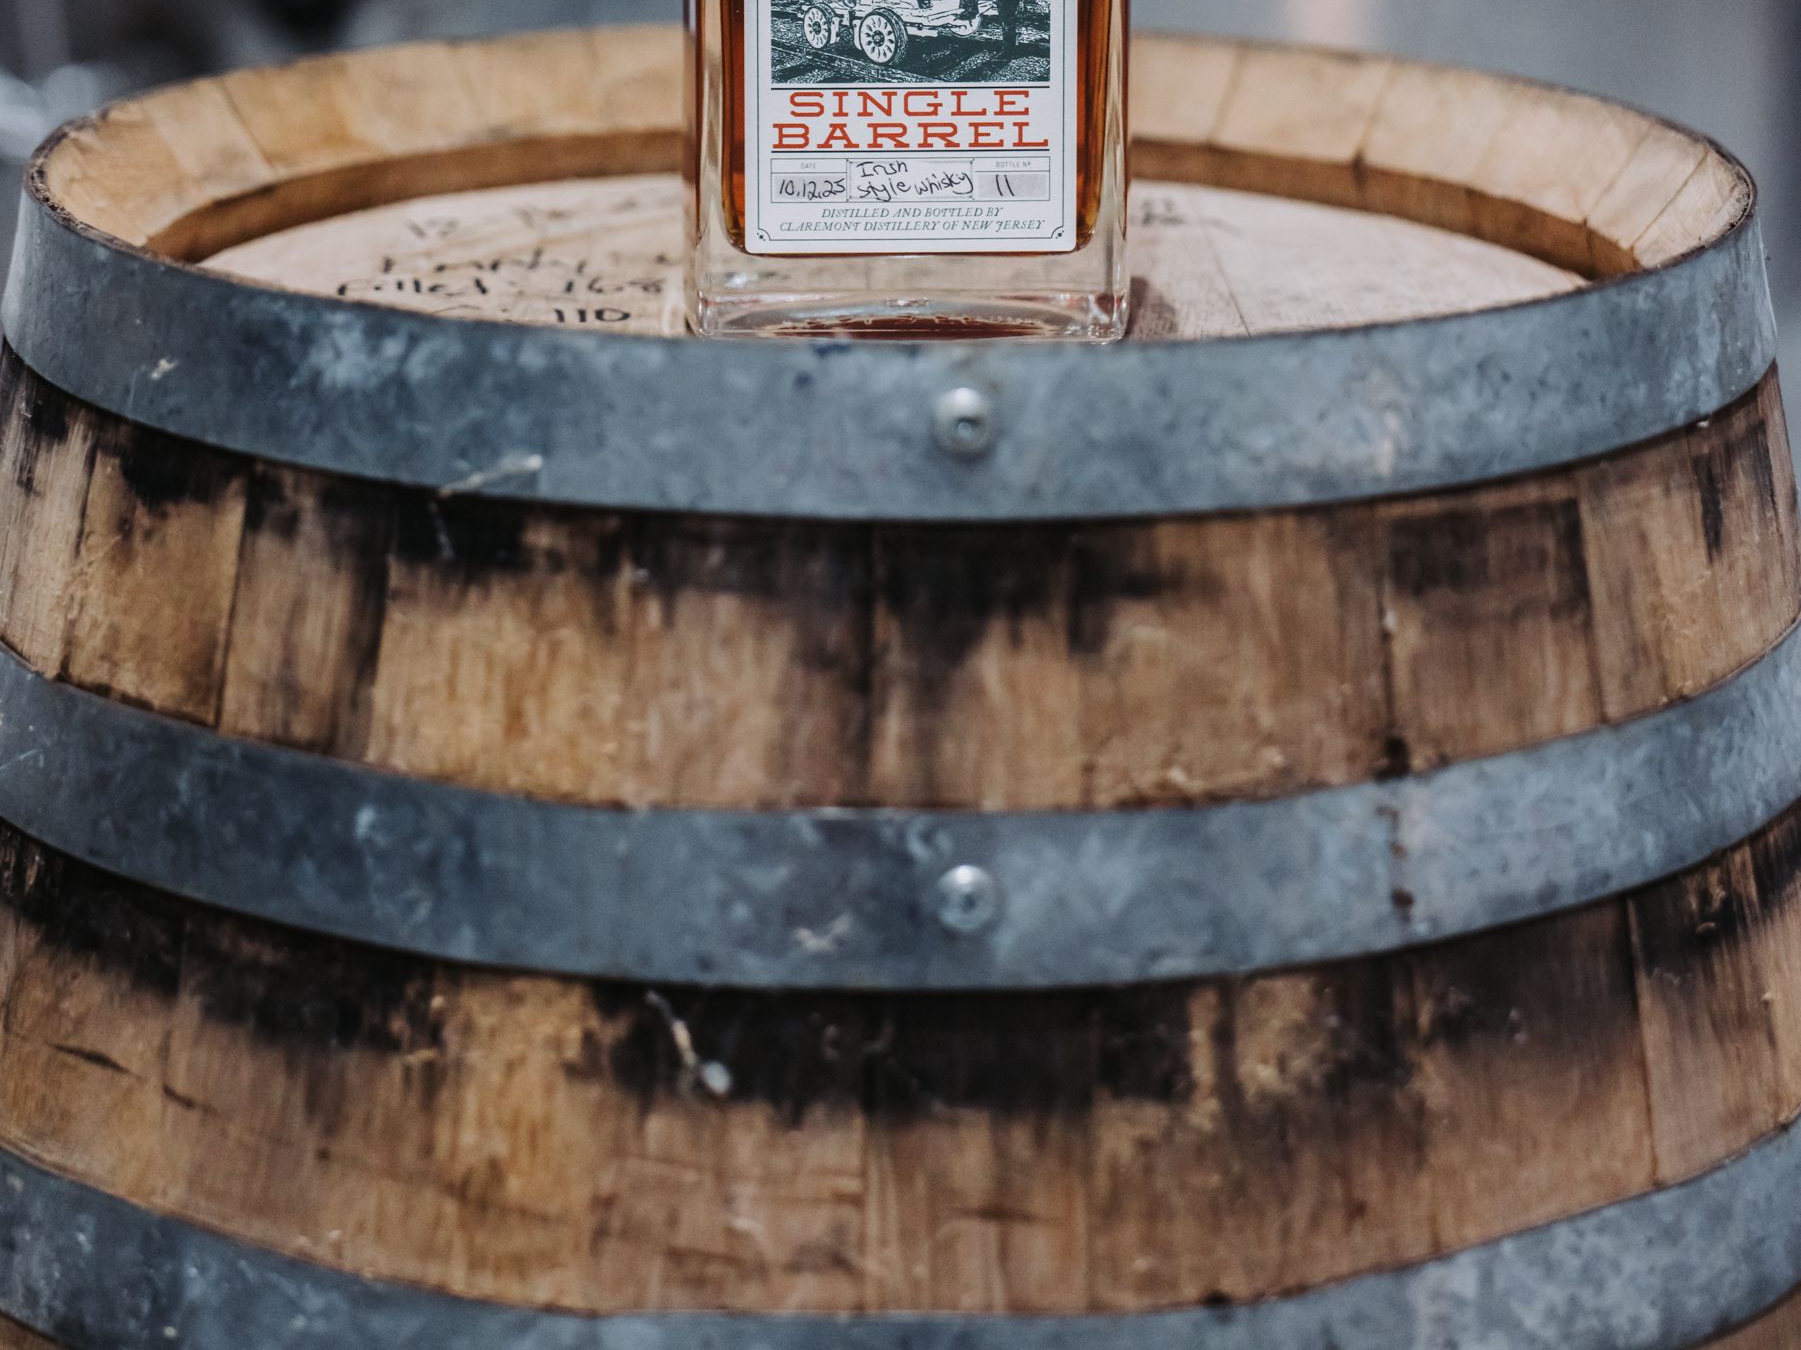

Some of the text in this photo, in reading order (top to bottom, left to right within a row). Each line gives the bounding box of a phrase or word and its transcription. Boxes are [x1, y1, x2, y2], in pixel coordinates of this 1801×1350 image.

[789, 90, 1029, 117] SINGLE
[772, 122, 1049, 149] BARREL
[822, 207, 1004, 218] DISTILLED AND BOTTLED BY
[780, 220, 1045, 233] CLAREMONT DISTILLERY OF NEW JERSEY
